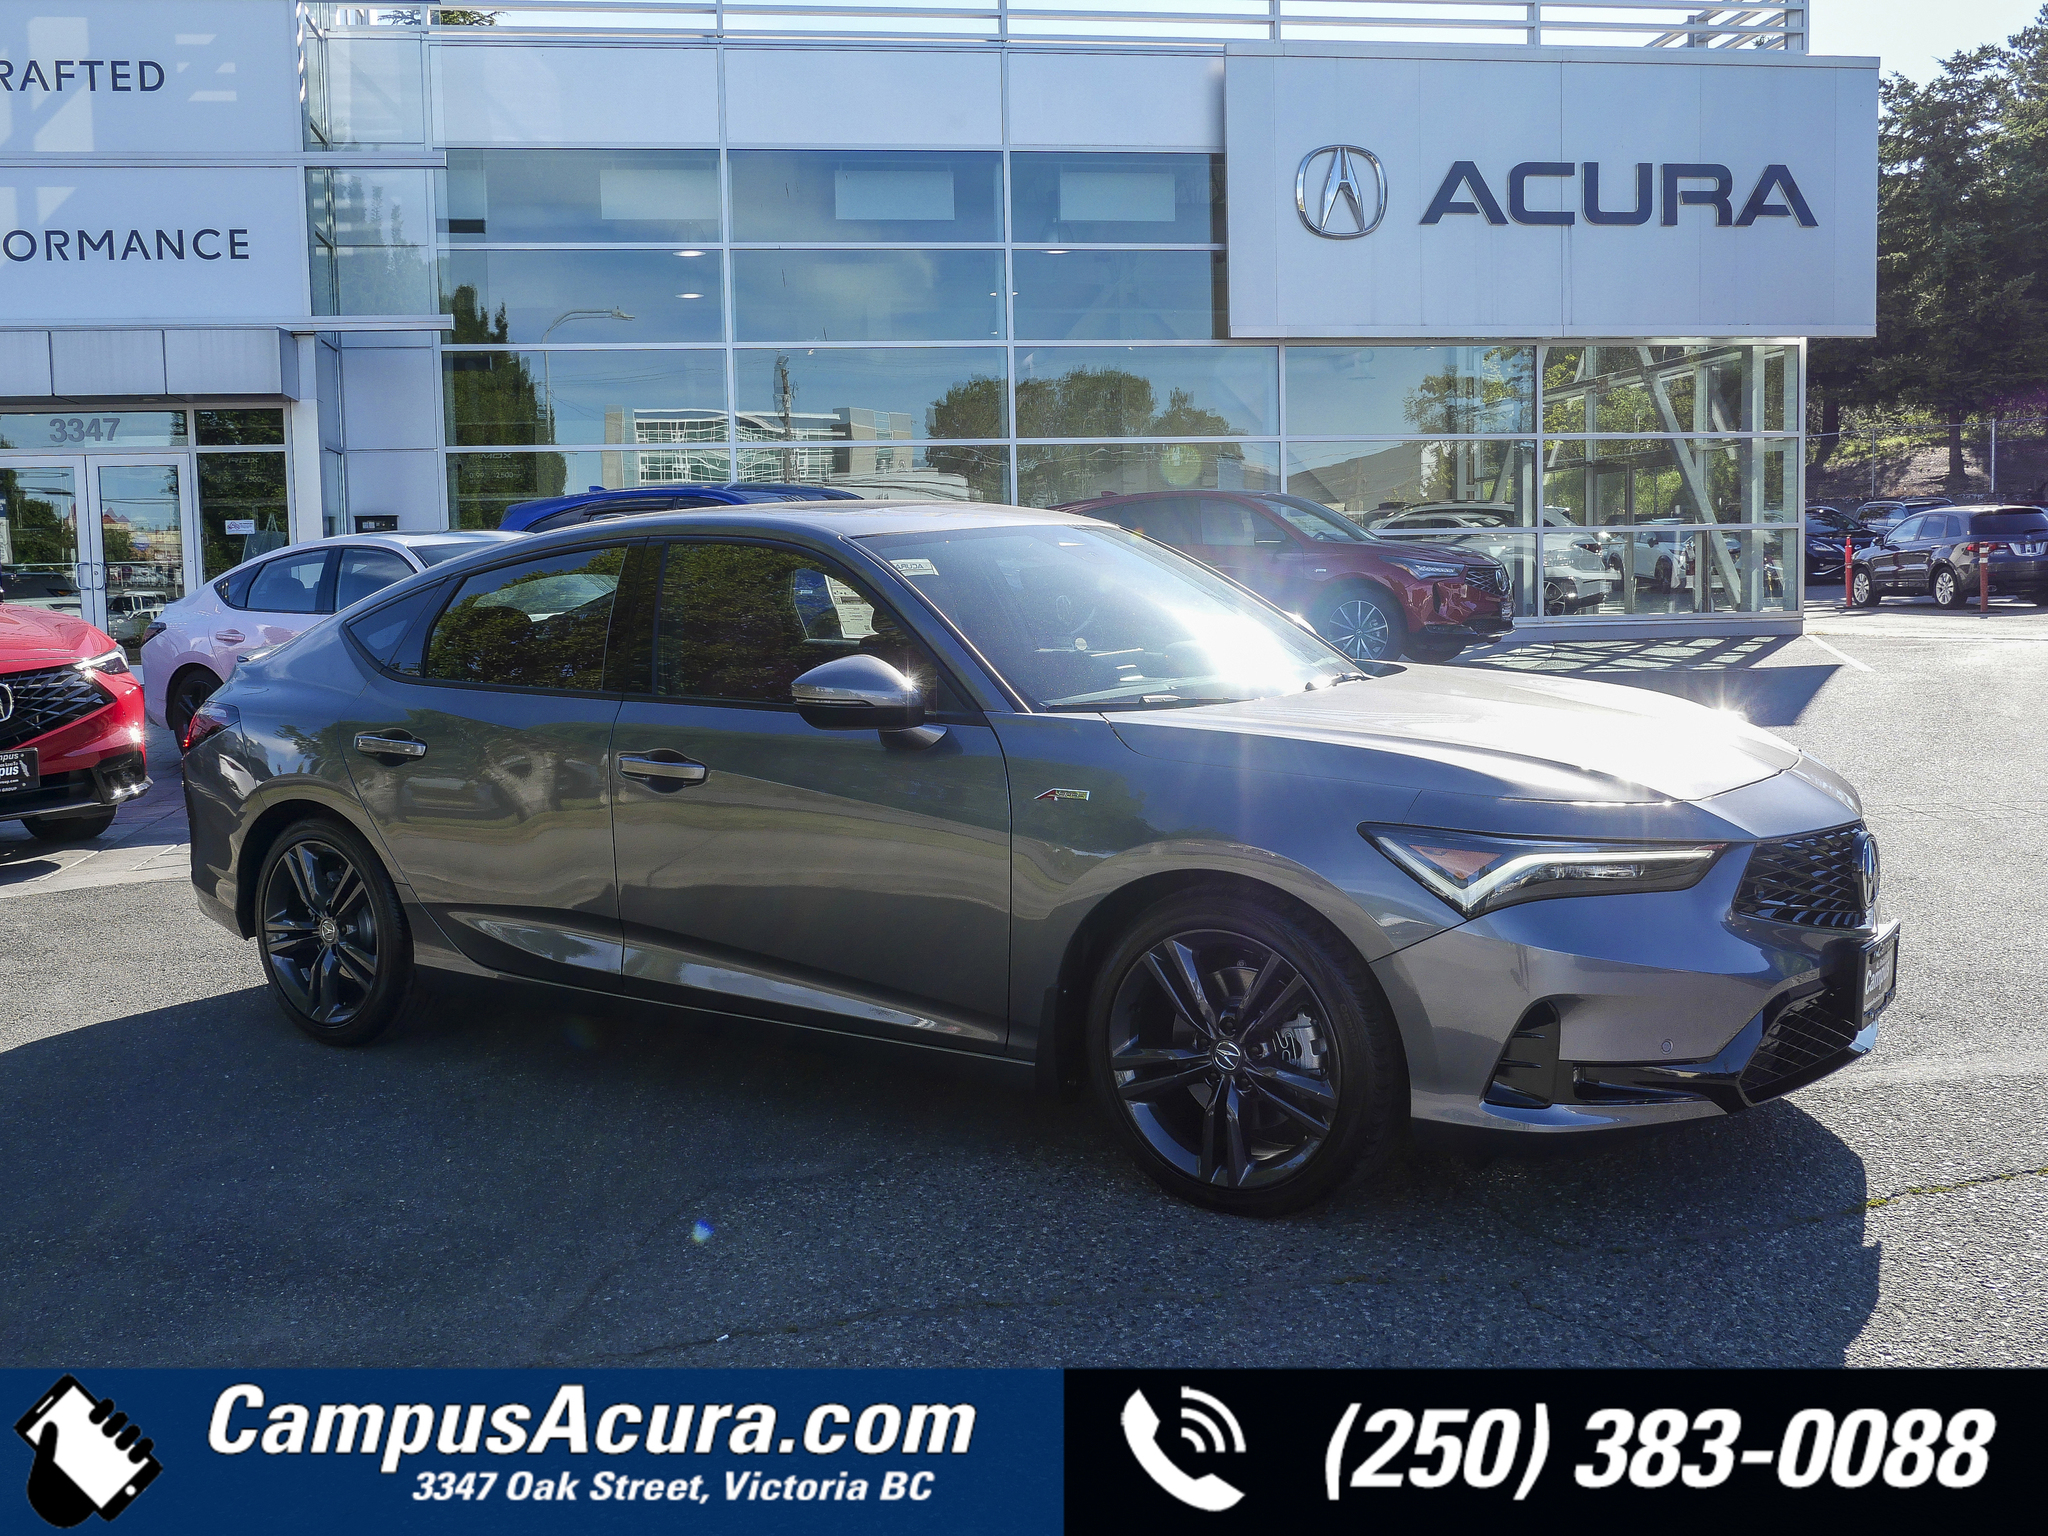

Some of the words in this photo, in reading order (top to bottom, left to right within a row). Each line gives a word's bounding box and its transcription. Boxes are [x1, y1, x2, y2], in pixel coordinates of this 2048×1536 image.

[0, 60, 165, 92] RAFTED
[1419, 161, 1819, 228] ACURA
[2, 228, 250, 262] ORMANCE
[50, 417, 120, 442] 3347
